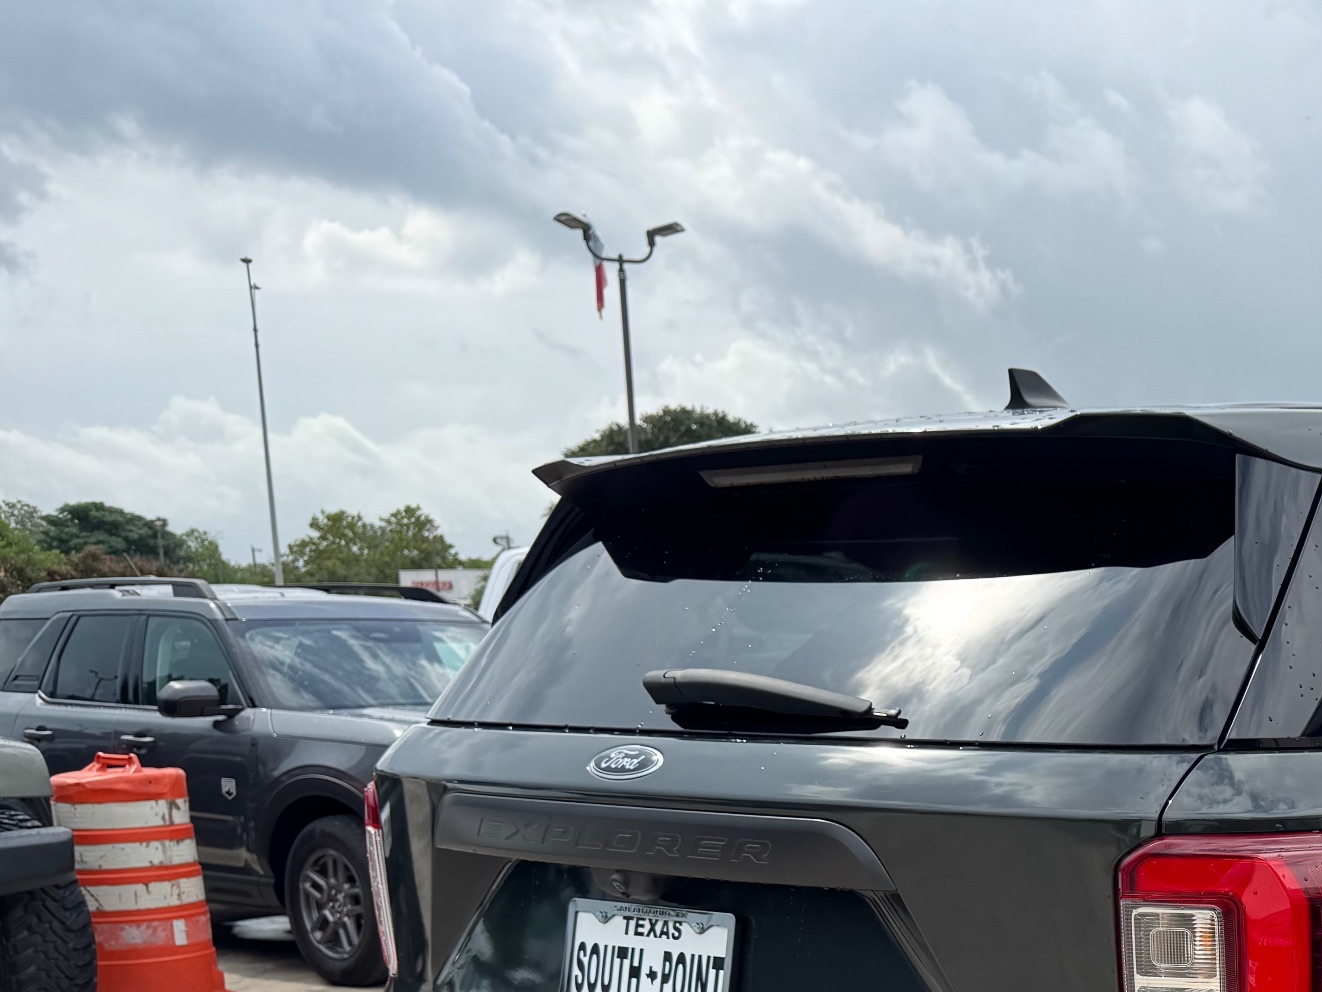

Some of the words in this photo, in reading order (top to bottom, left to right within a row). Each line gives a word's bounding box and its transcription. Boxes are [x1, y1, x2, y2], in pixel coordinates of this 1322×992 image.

[600, 749, 643, 771] Ford
[476, 817, 772, 865] EXPLORER
[622, 915, 683, 940] TEXAS
